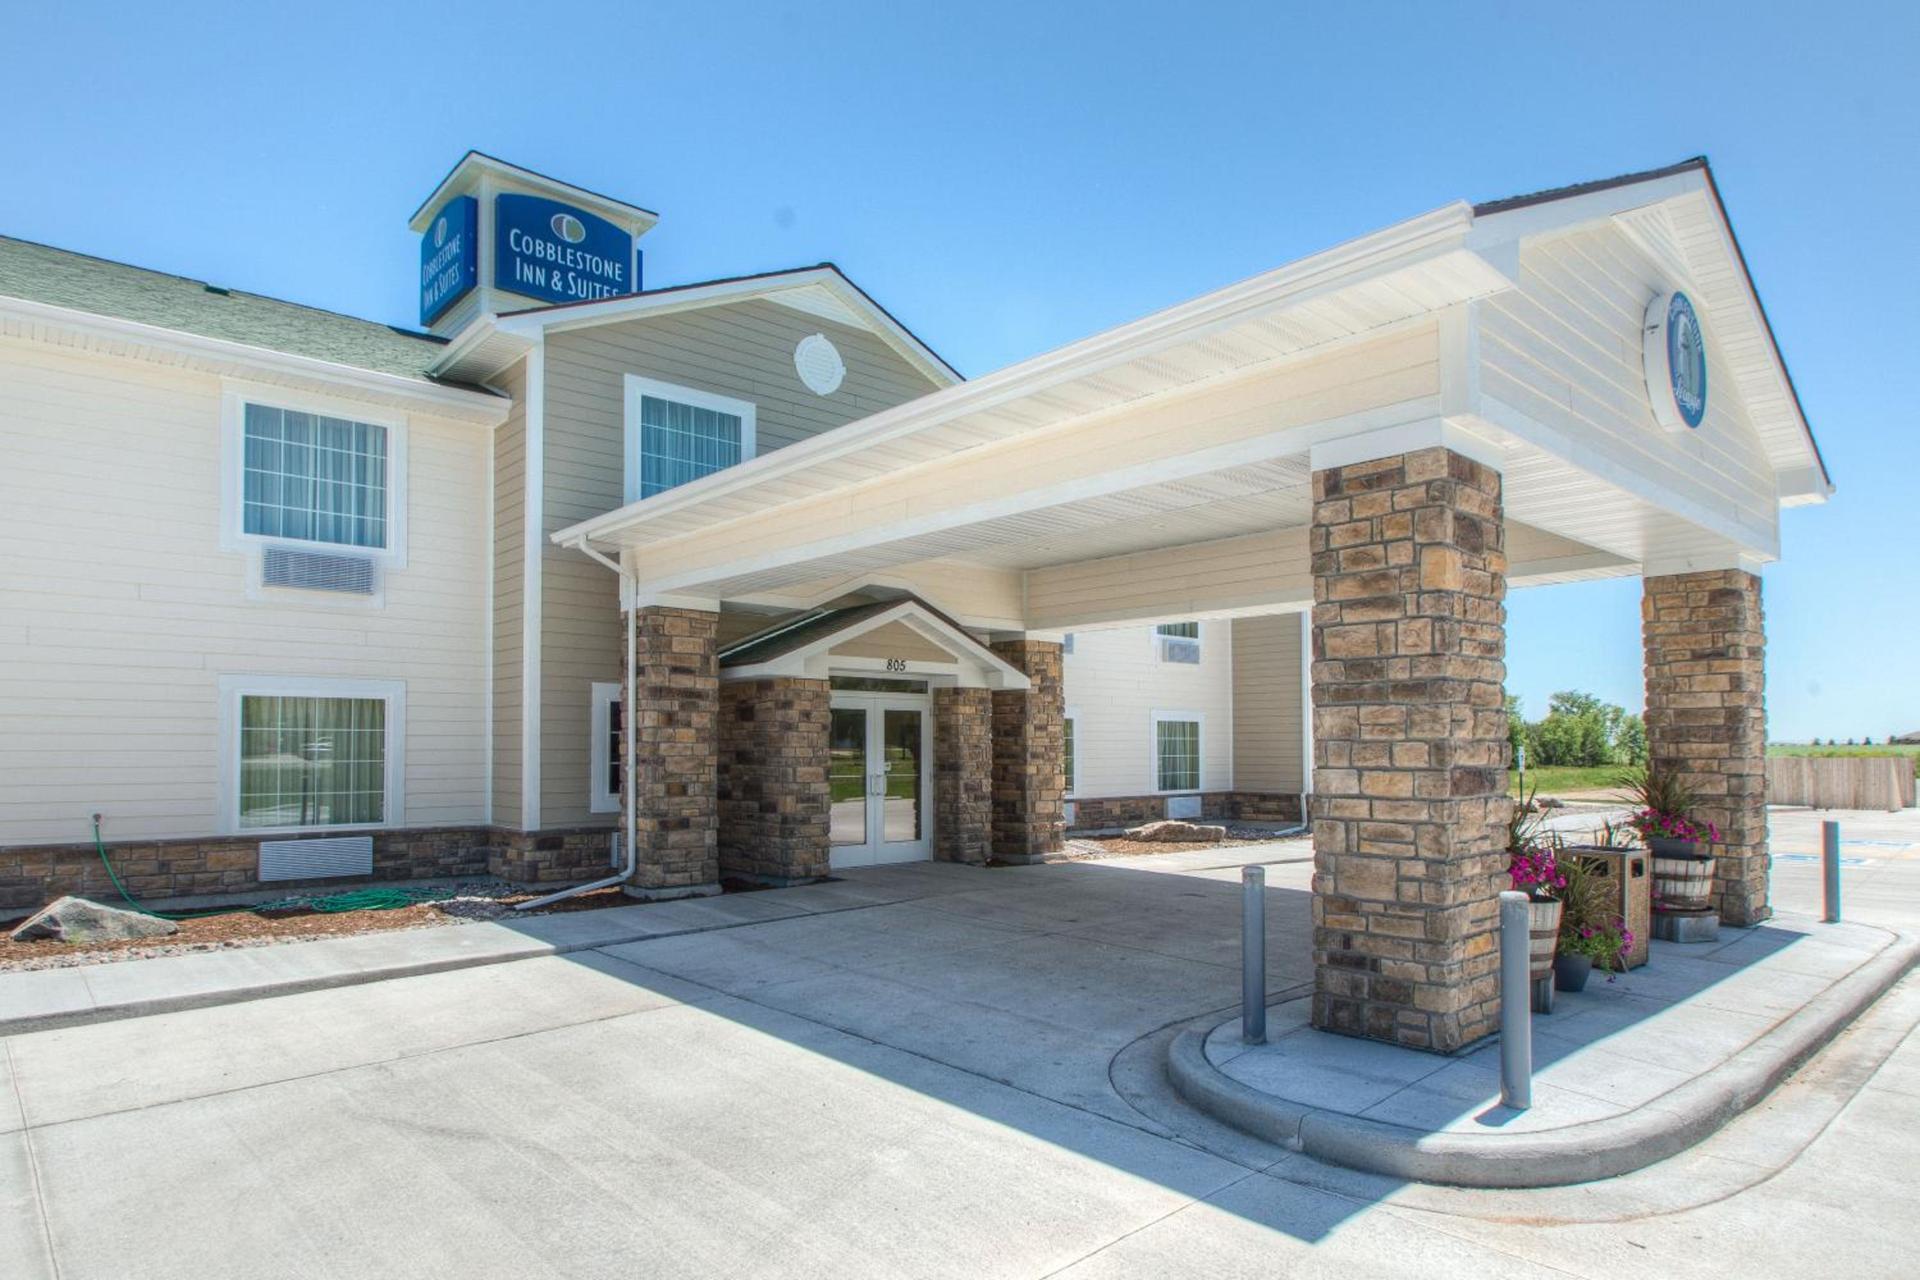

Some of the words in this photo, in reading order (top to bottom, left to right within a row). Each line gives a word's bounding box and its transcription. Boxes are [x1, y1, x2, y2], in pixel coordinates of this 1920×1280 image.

[510, 228, 623, 282] COBBLESTONE
[439, 263, 459, 298] SUITES
[515, 257, 545, 288] INN
[551, 271, 563, 291] &
[886, 658, 906, 672] 805
